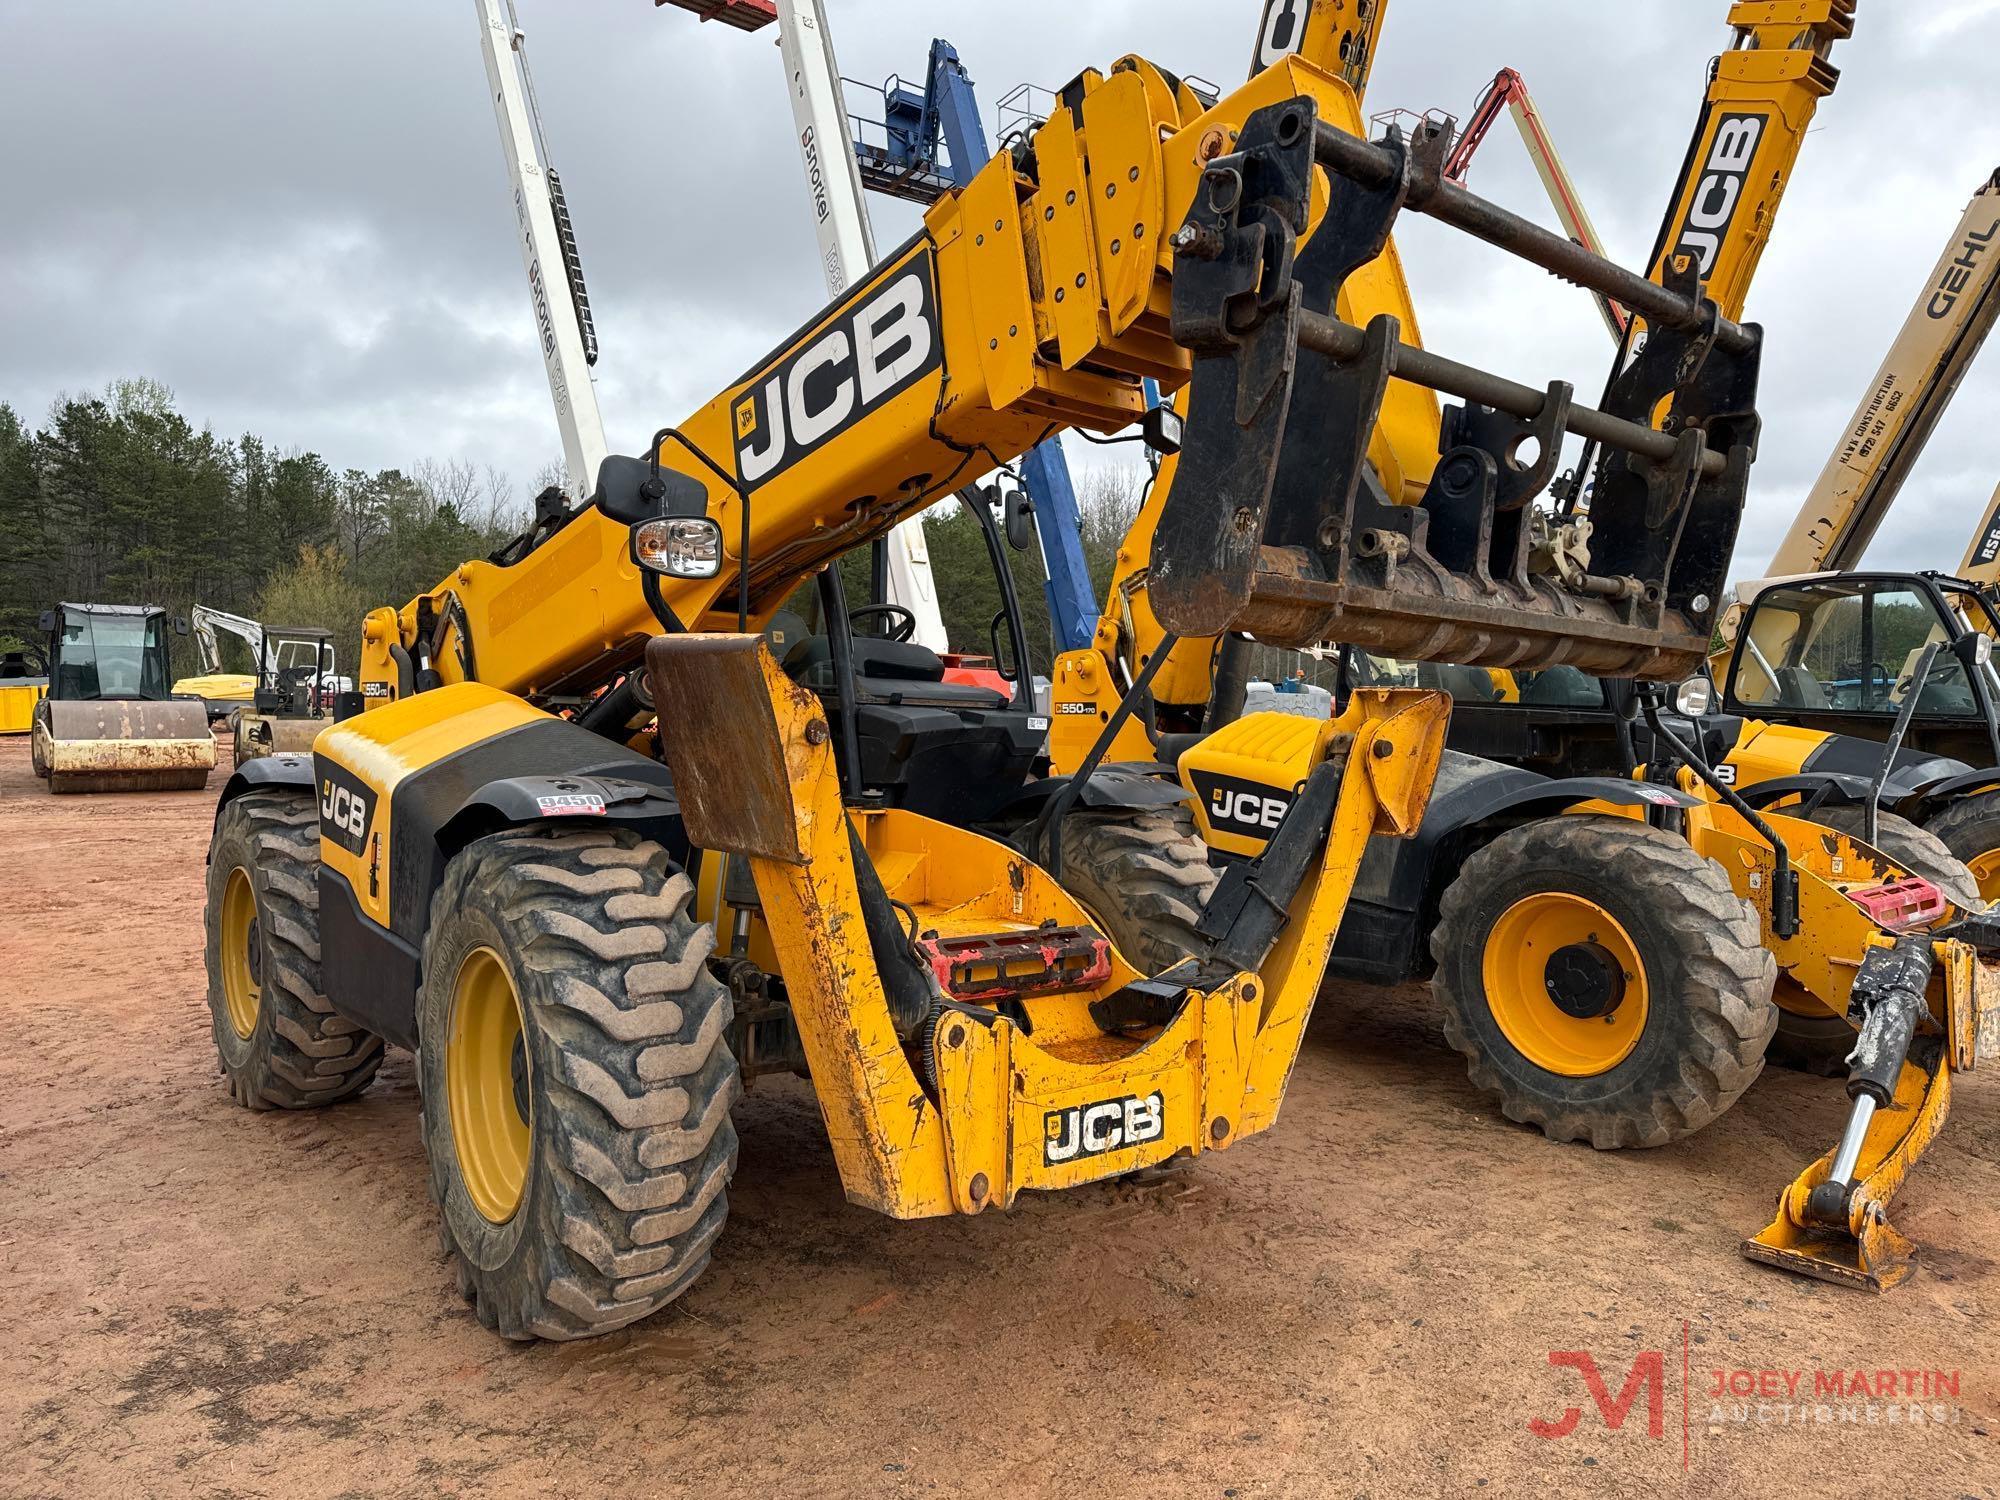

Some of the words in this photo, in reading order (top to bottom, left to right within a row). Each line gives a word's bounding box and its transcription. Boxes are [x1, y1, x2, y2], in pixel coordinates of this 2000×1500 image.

[805, 146, 830, 225] snorkel
[1680, 117, 1761, 275] JCB
[825, 242, 845, 297] TB85
[1926, 219, 2000, 320] GEHL
[532, 278, 556, 360] snorkel
[739, 274, 931, 482] JCB
[1871, 420, 1886, 437] 547
[1886, 391, 1904, 412] 6652
[1839, 438, 1859, 464] HAWK
[1854, 373, 1897, 437] CONSTRUCTION
[322, 782, 366, 838] JCB
[540, 795, 602, 807] 9450
[1211, 790, 1289, 829] JCB
[1047, 1095, 1162, 1161] JCB
